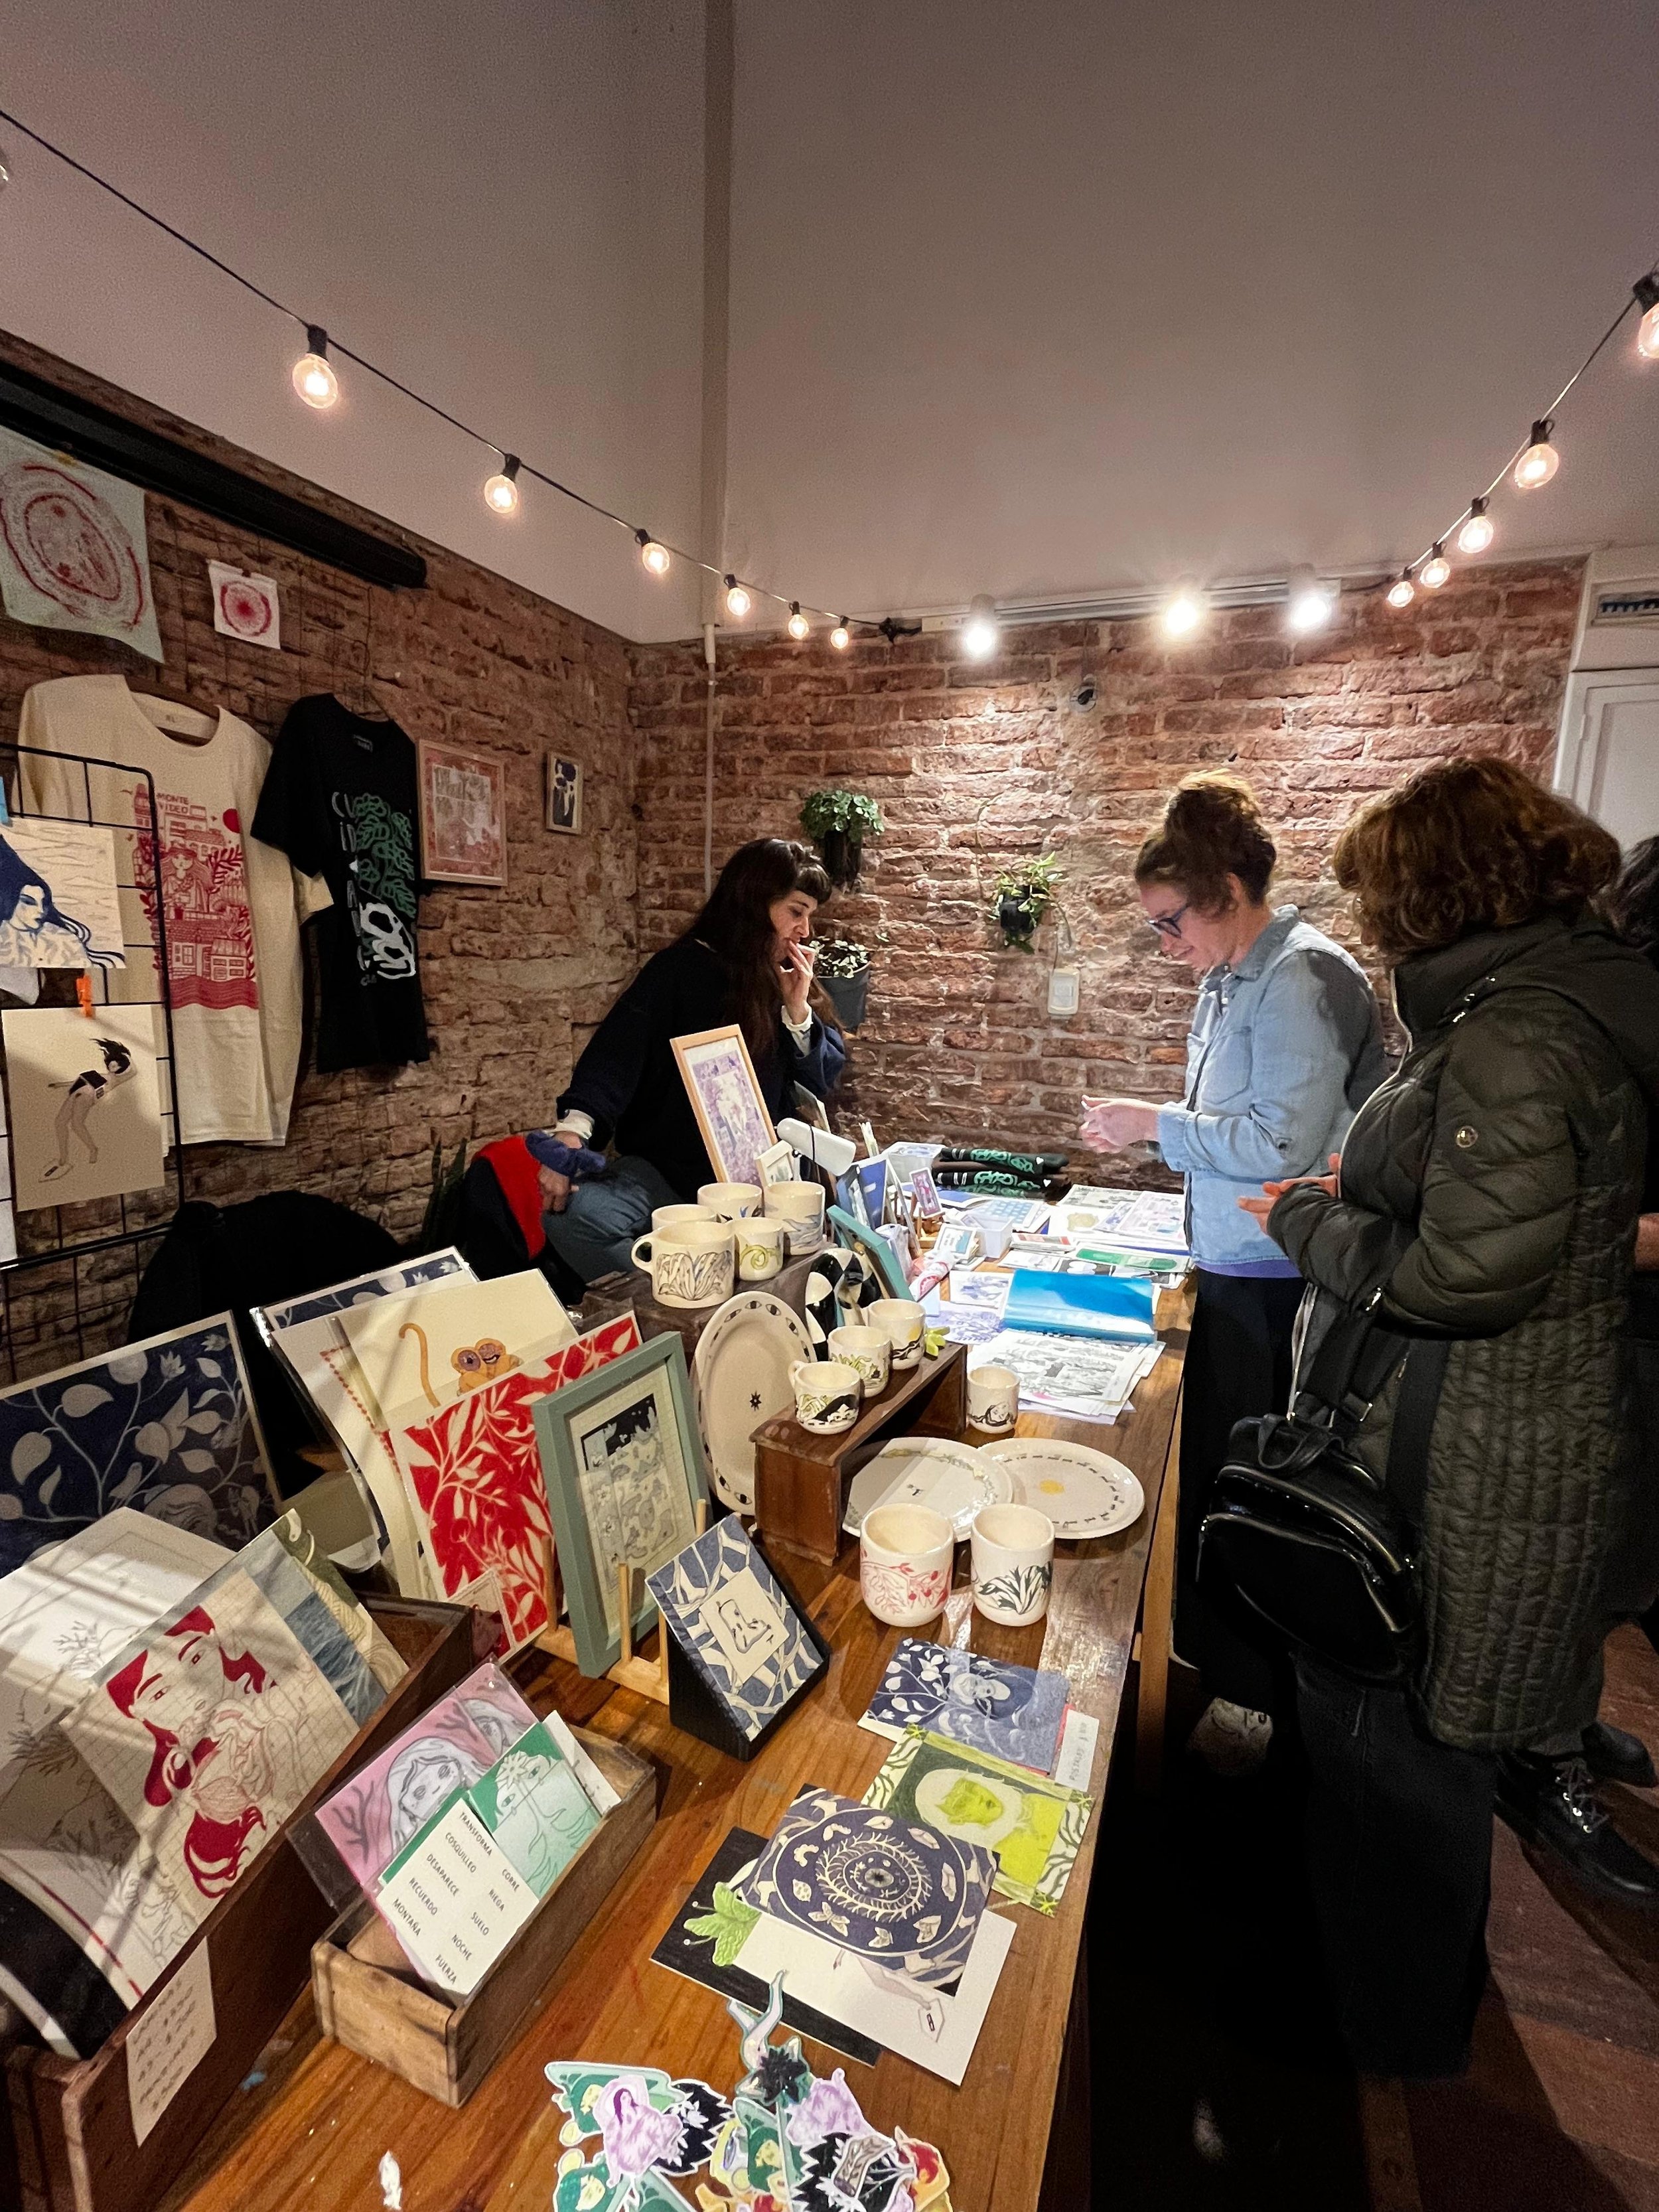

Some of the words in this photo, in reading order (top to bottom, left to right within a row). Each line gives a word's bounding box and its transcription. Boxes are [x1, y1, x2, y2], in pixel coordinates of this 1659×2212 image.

[156, 793, 188, 805] MONTE
[159, 802, 188, 814] VIDEO
[460, 1812, 492, 1856] TRANSFORMA
[446, 1832, 476, 1872] COSQUILLEO
[427, 1854, 459, 1895] DESAPARECE
[502, 1869, 519, 1891] CORRE
[409, 1878, 437, 1915] RECUERDO
[489, 1889, 504, 1911] RIEGA
[394, 1899, 421, 1936] MONTAÑA
[471, 1912, 489, 1935] SUELO
[452, 1935, 472, 1960] NOCHE
[436, 1954, 457, 1984] FUERZA
